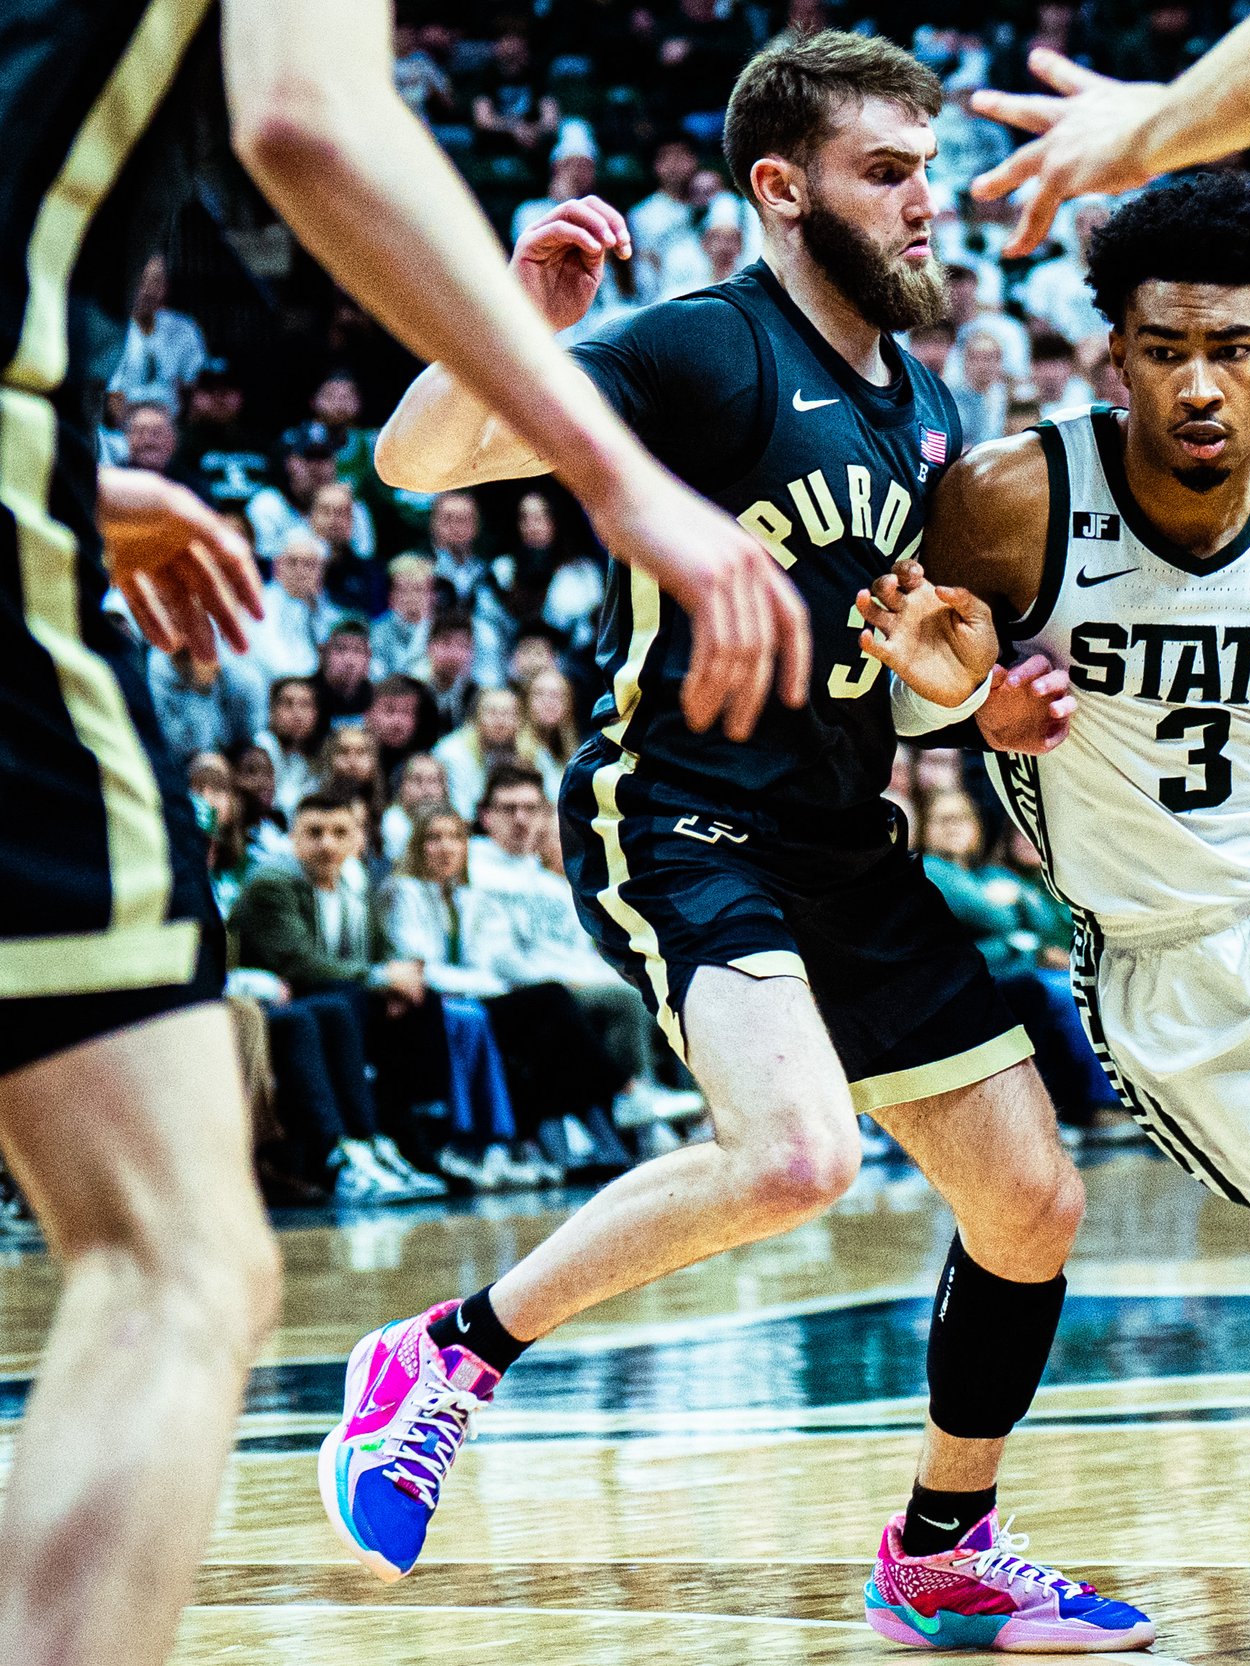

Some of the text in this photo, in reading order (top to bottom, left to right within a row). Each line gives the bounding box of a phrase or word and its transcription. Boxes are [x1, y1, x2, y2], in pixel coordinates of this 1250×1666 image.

[736, 464, 924, 571] PURD
[1082, 513, 1110, 538] JF
[827, 596, 889, 699] 3
[1155, 707, 1232, 813] 3
